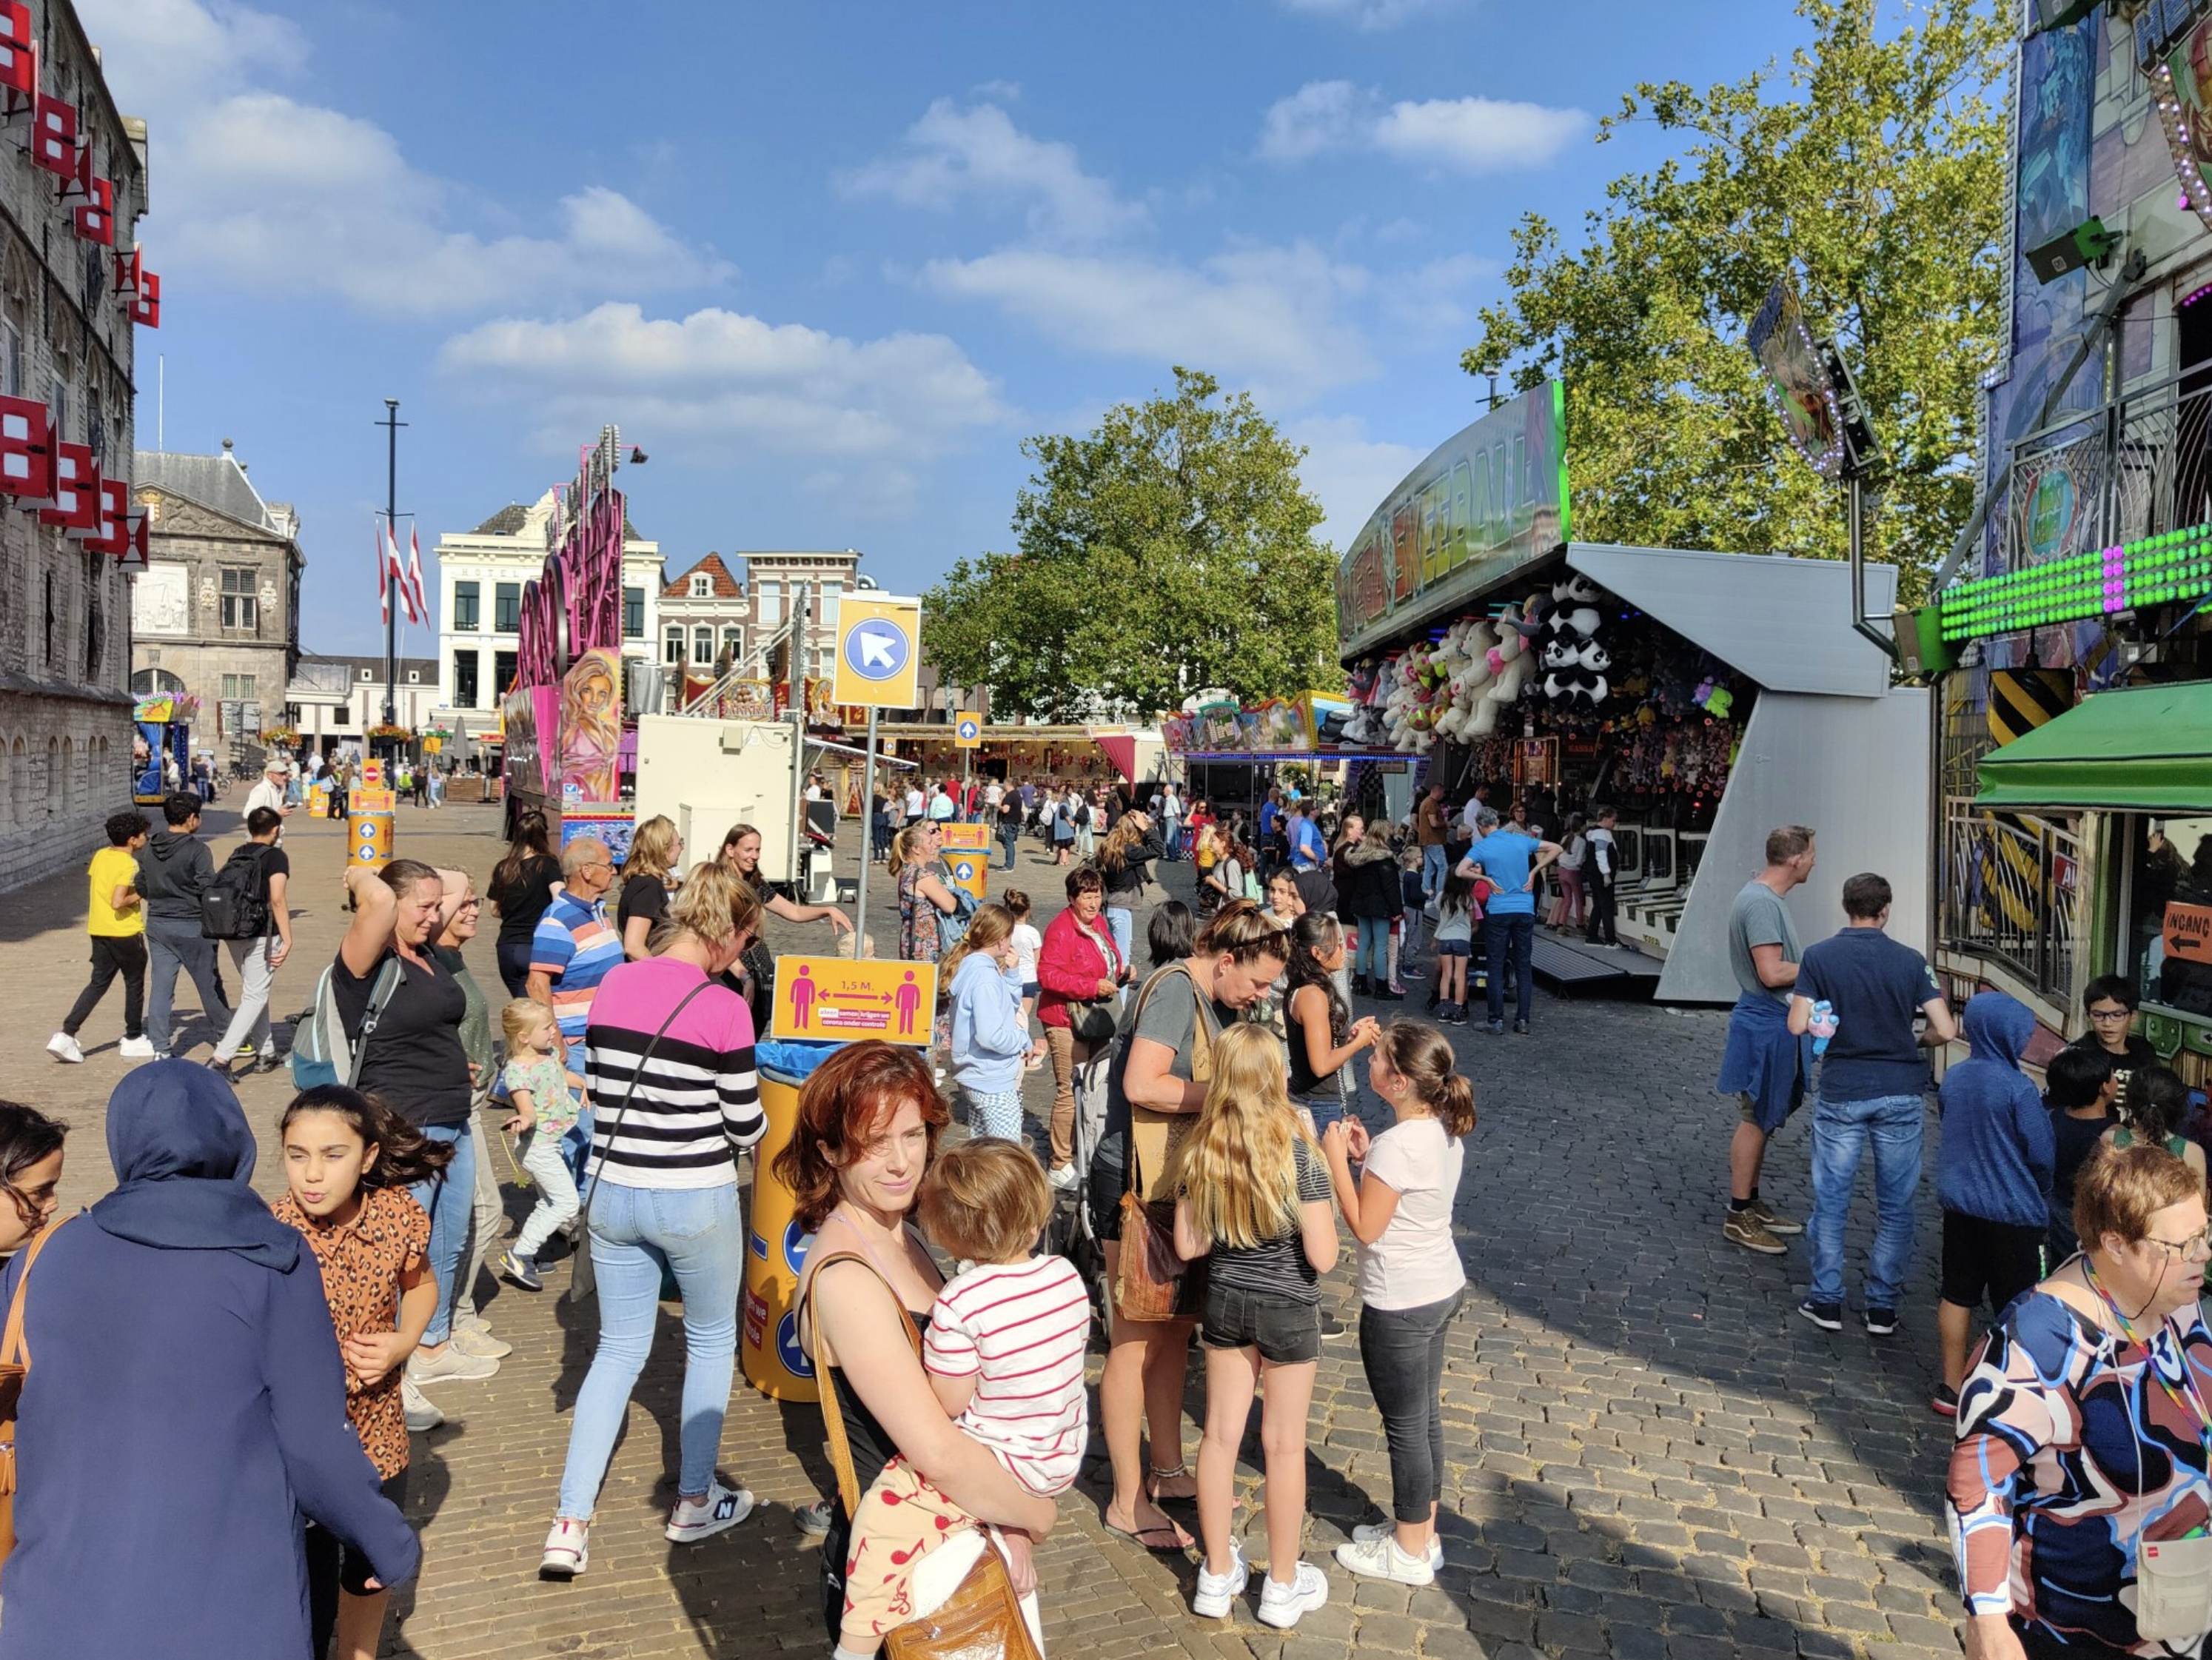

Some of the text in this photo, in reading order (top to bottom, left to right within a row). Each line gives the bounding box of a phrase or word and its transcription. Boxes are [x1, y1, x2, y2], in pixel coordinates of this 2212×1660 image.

[1393, 436, 1535, 603] SKEEBALL
[462, 569, 518, 578] HOTEL
[841, 981, 857, 991] 1,5
[755, 1305, 767, 1320] we
[717, 1502, 732, 1518] N
